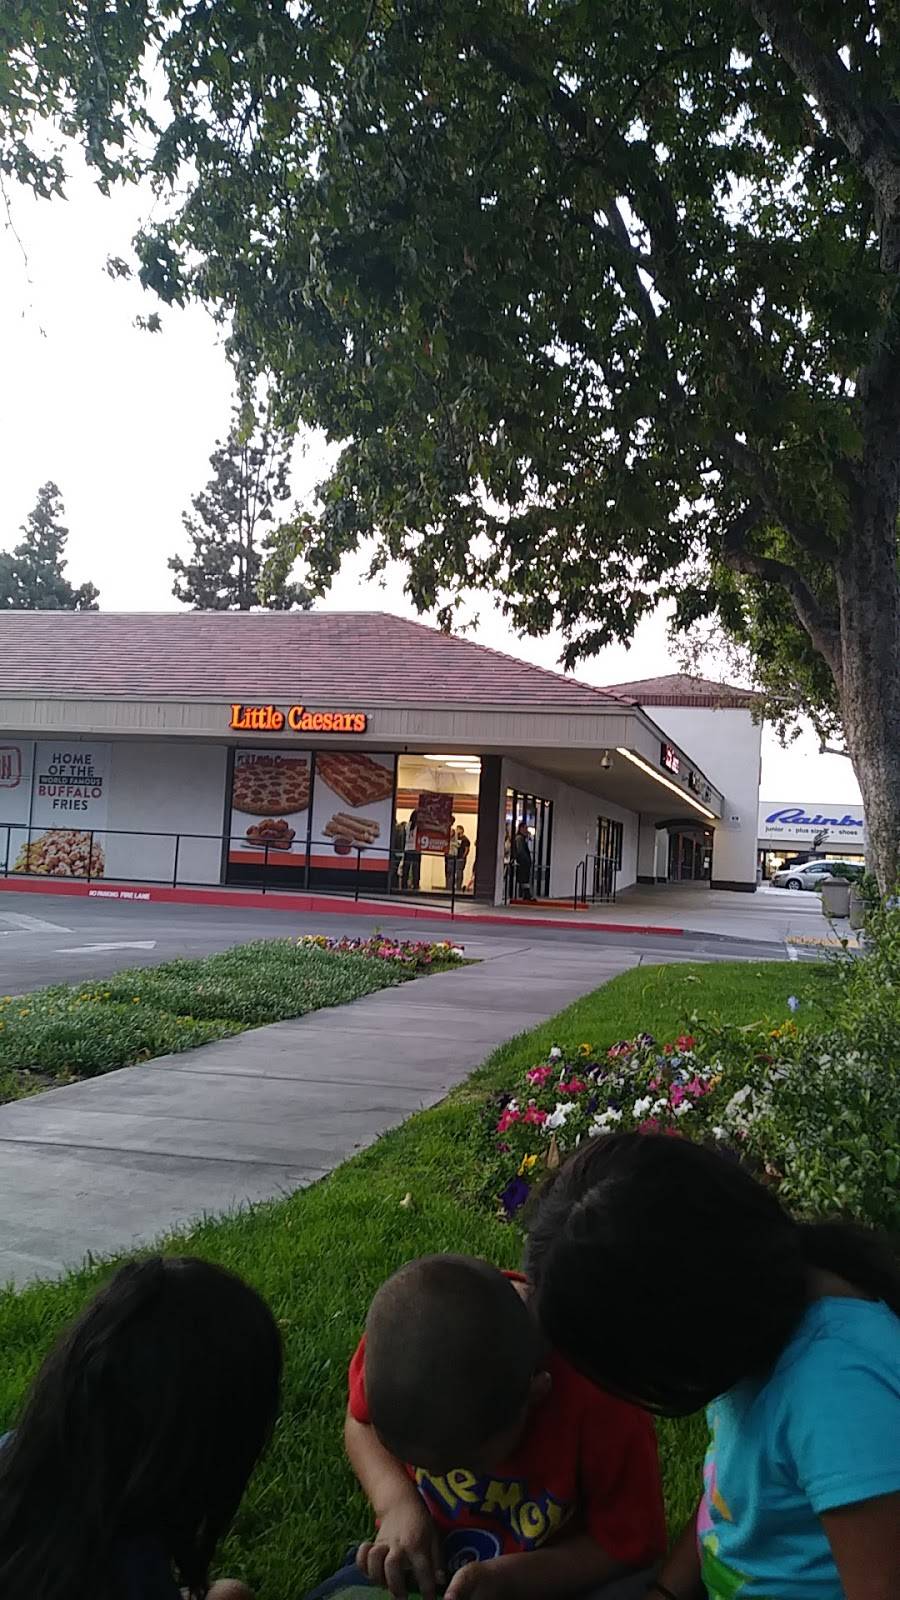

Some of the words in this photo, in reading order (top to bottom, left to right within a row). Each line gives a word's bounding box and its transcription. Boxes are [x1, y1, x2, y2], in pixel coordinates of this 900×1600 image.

[230, 704, 285, 731] Little
[287, 704, 367, 733] Caesars
[52, 753, 92, 765] HOME
[48, 765, 66, 775] OF
[70, 765, 95, 777] THE
[41, 776, 68, 784] WORLD
[69, 777, 101, 786] FAMOUS
[39, 785, 102, 798] BUFFALO
[52, 799, 88, 810] FRIES
[120, 891, 134, 899] FIRE
[134, 892, 150, 900] LANE
